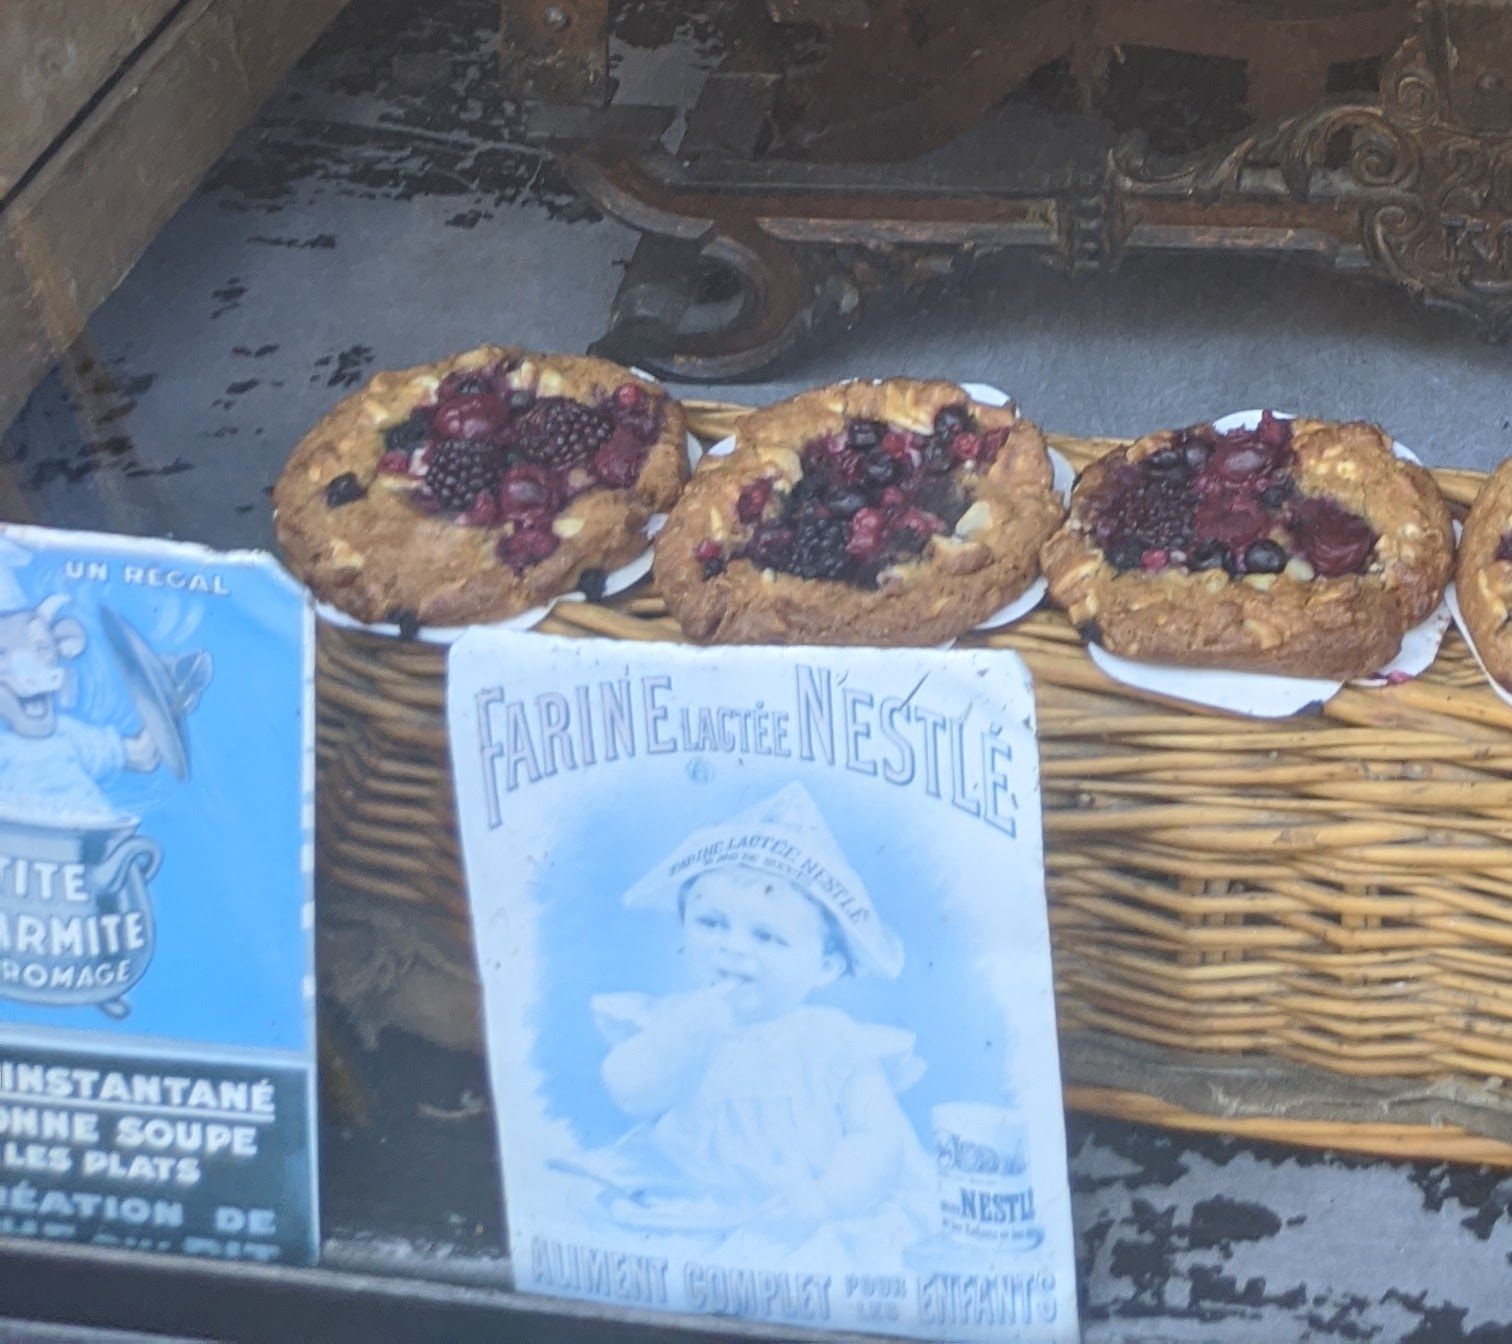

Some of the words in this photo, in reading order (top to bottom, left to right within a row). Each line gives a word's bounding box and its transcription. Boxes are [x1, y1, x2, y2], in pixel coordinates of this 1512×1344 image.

[65, 560, 109, 582] UN
[475, 674, 678, 831] FARINE
[680, 700, 792, 759] LACTÉE
[795, 663, 1016, 840] NESTLÉ
[1, 1060, 276, 1113] INSTANTANÉ
[115, 1116, 258, 1158] SOUPE
[4, 1142, 73, 1174] LES
[82, 1150, 201, 1187] PLATS
[0, 1180, 184, 1228] ÉATION
[215, 1207, 277, 1236] DE
[531, 1235, 669, 1306] ALIMENT
[683, 1259, 832, 1322] COMPLET
[917, 1271, 1057, 1327] ENFANTS
